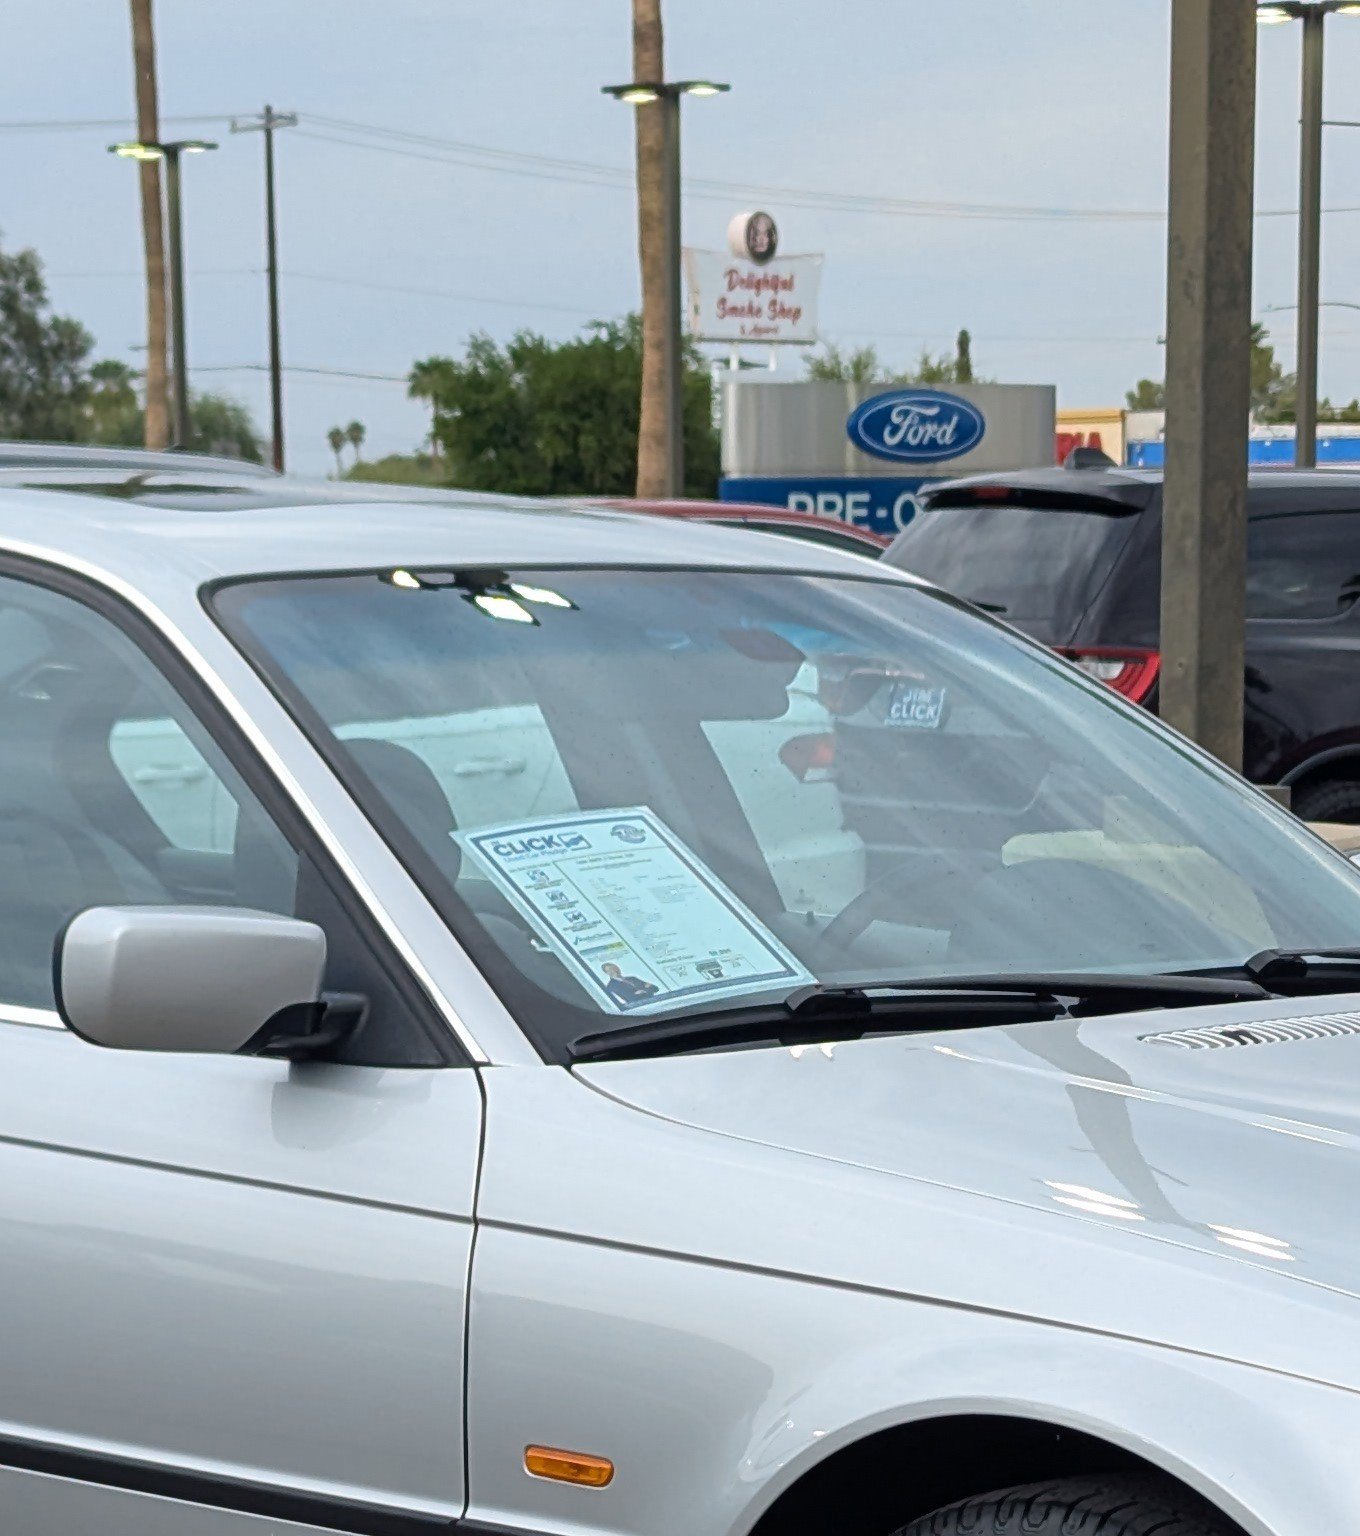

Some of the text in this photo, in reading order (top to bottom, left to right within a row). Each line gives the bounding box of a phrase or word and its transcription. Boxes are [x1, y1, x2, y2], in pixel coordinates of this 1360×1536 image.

[717, 297, 801, 324] Smoke Shop
[883, 405, 958, 446] Ford
[891, 702, 938, 720] CLICK
[493, 835, 561, 856] CLICK
